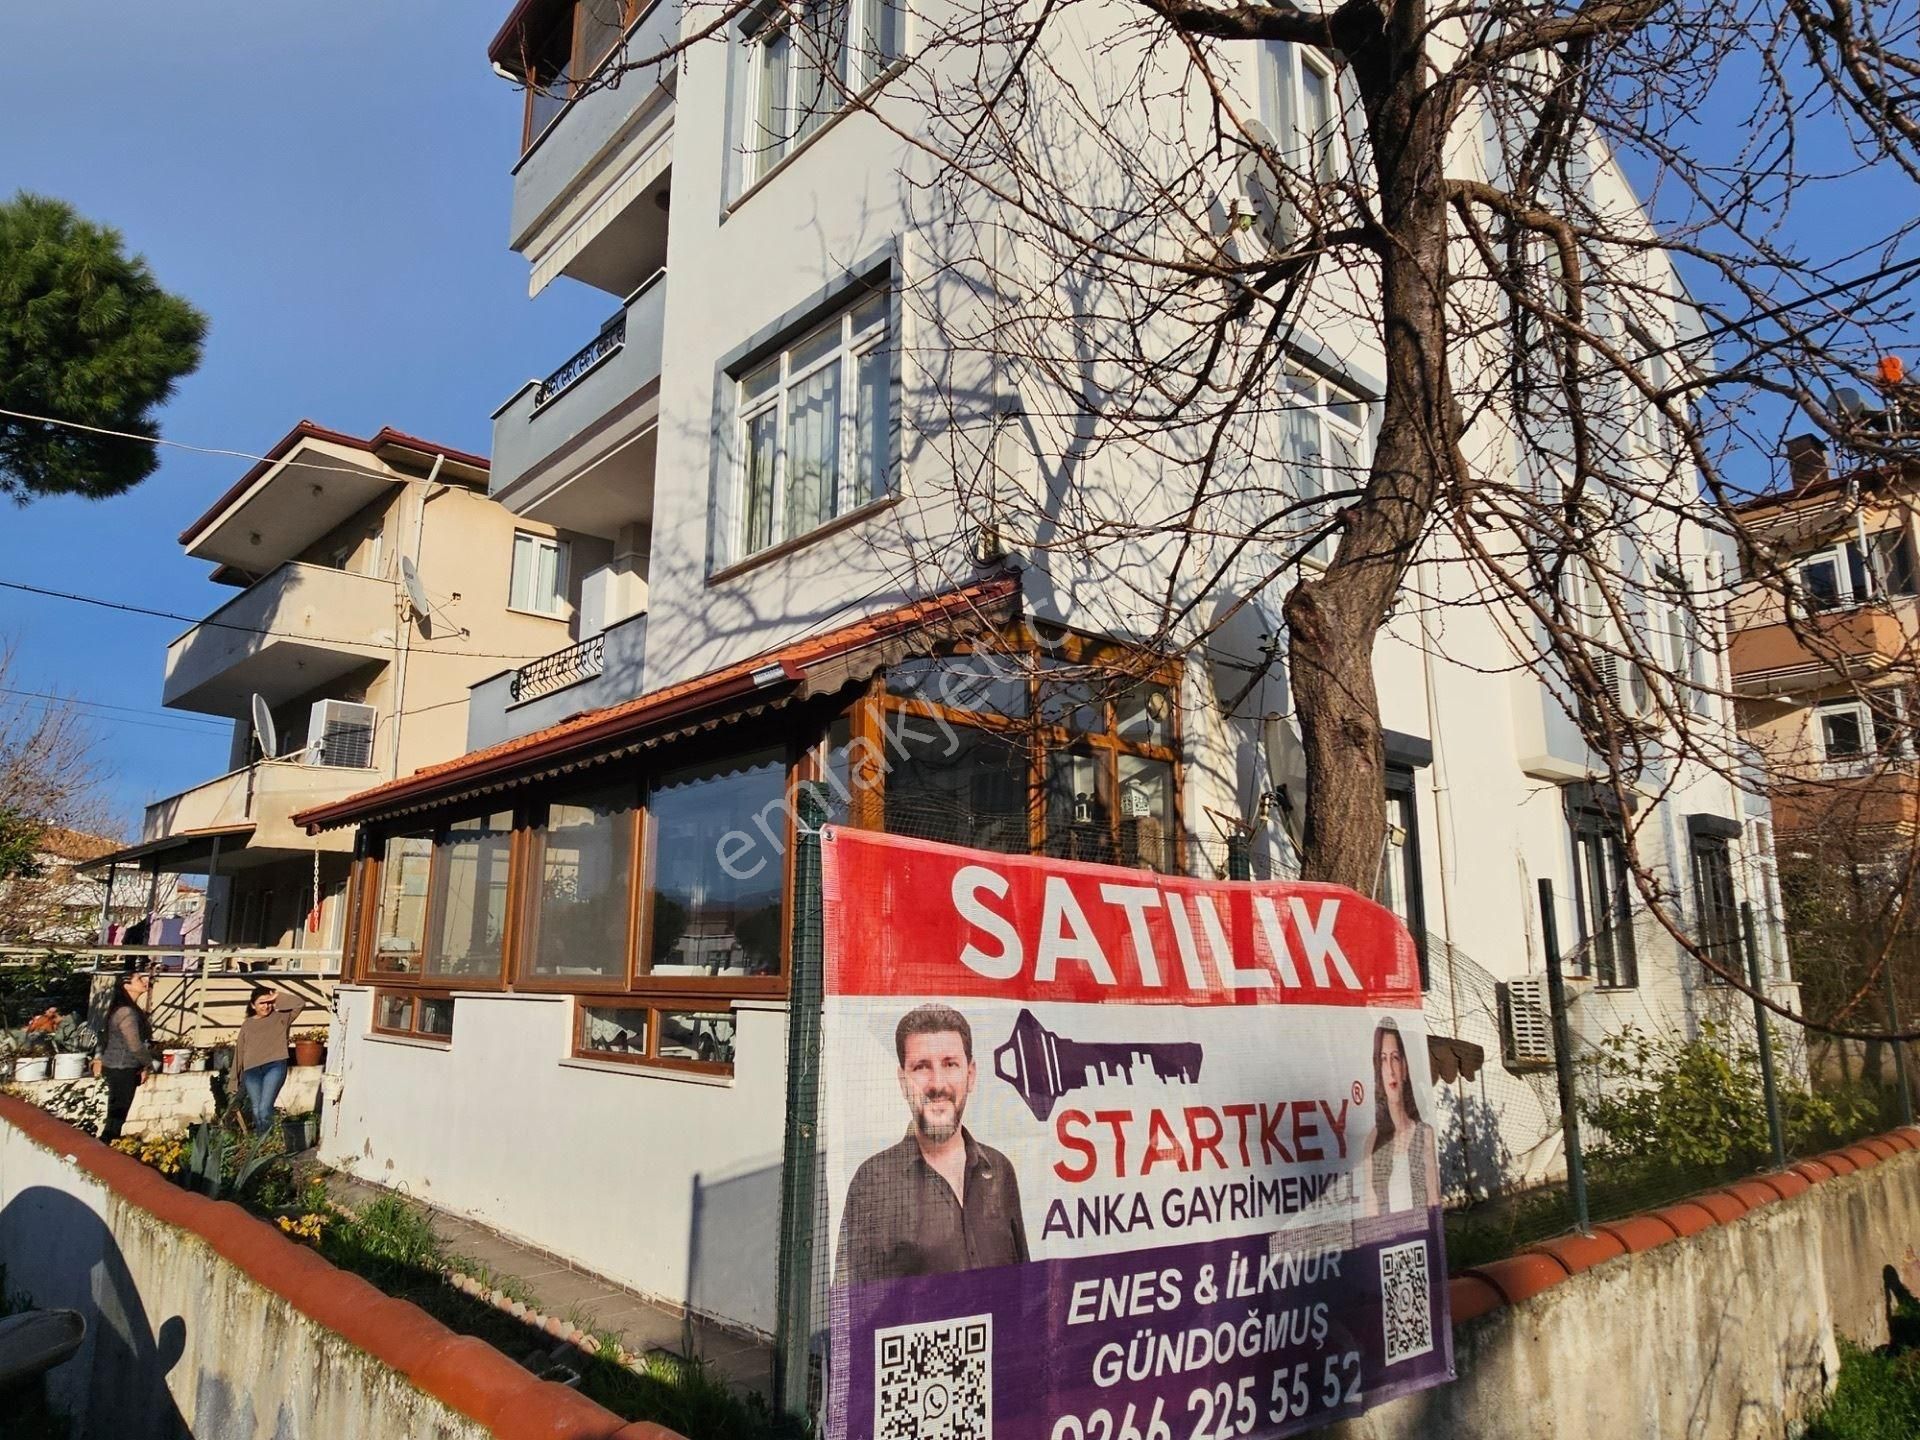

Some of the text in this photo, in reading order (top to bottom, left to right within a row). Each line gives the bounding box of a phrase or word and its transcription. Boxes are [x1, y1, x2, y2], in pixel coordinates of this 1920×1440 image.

[951, 865, 1363, 990] SATILIK
[1041, 1191, 1154, 1241] ANKA
[1067, 1248, 1343, 1325] ENES & İLKNUR
[1092, 1302, 1329, 1388] GÜNDOĞMUŞ
[1187, 1376, 1257, 1440] 225
[1269, 1363, 1310, 1424] 55
[1322, 1351, 1363, 1408] 52
